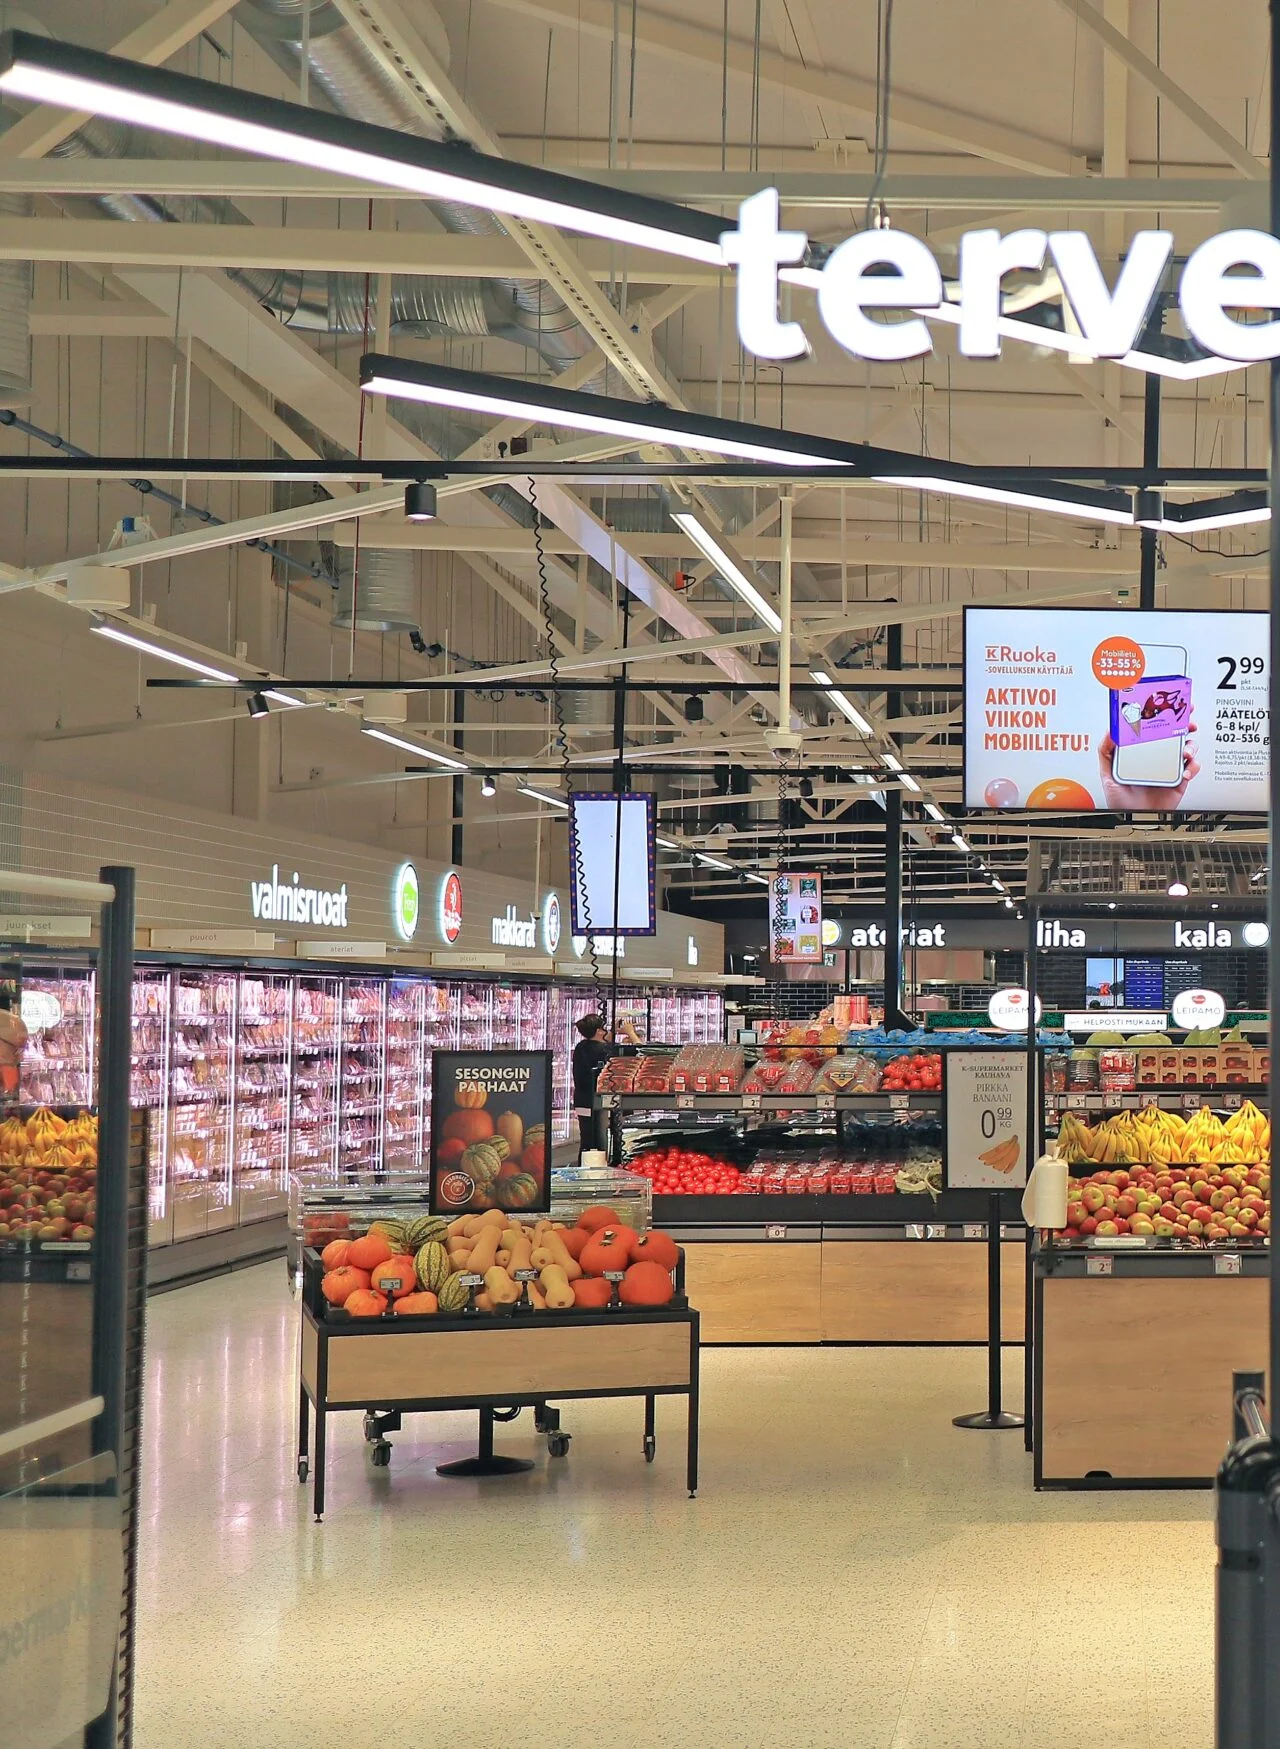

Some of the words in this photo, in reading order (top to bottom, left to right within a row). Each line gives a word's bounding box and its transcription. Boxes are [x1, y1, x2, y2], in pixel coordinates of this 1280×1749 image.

[1000, 645, 1056, 663] Ruoka
[1037, 665, 1073, 675] KÄYTTÄJÄ
[985, 688, 1056, 706] AKTIVOI
[985, 711, 1047, 728] VIIKON
[1238, 721, 1260, 733] kpl/
[984, 733, 1089, 752] MOBIILIETU!
[251, 864, 348, 927] valmisruoat
[1036, 920, 1086, 947] liha
[1174, 921, 1232, 948] kala
[455, 1067, 530, 1080] SESONGIN
[458, 1080, 527, 1093] PARHAAT
[976, 1083, 1009, 1092] PIRKKA
[973, 1093, 1012, 1103] BANAANI
[997, 1107, 1012, 1119] 99
